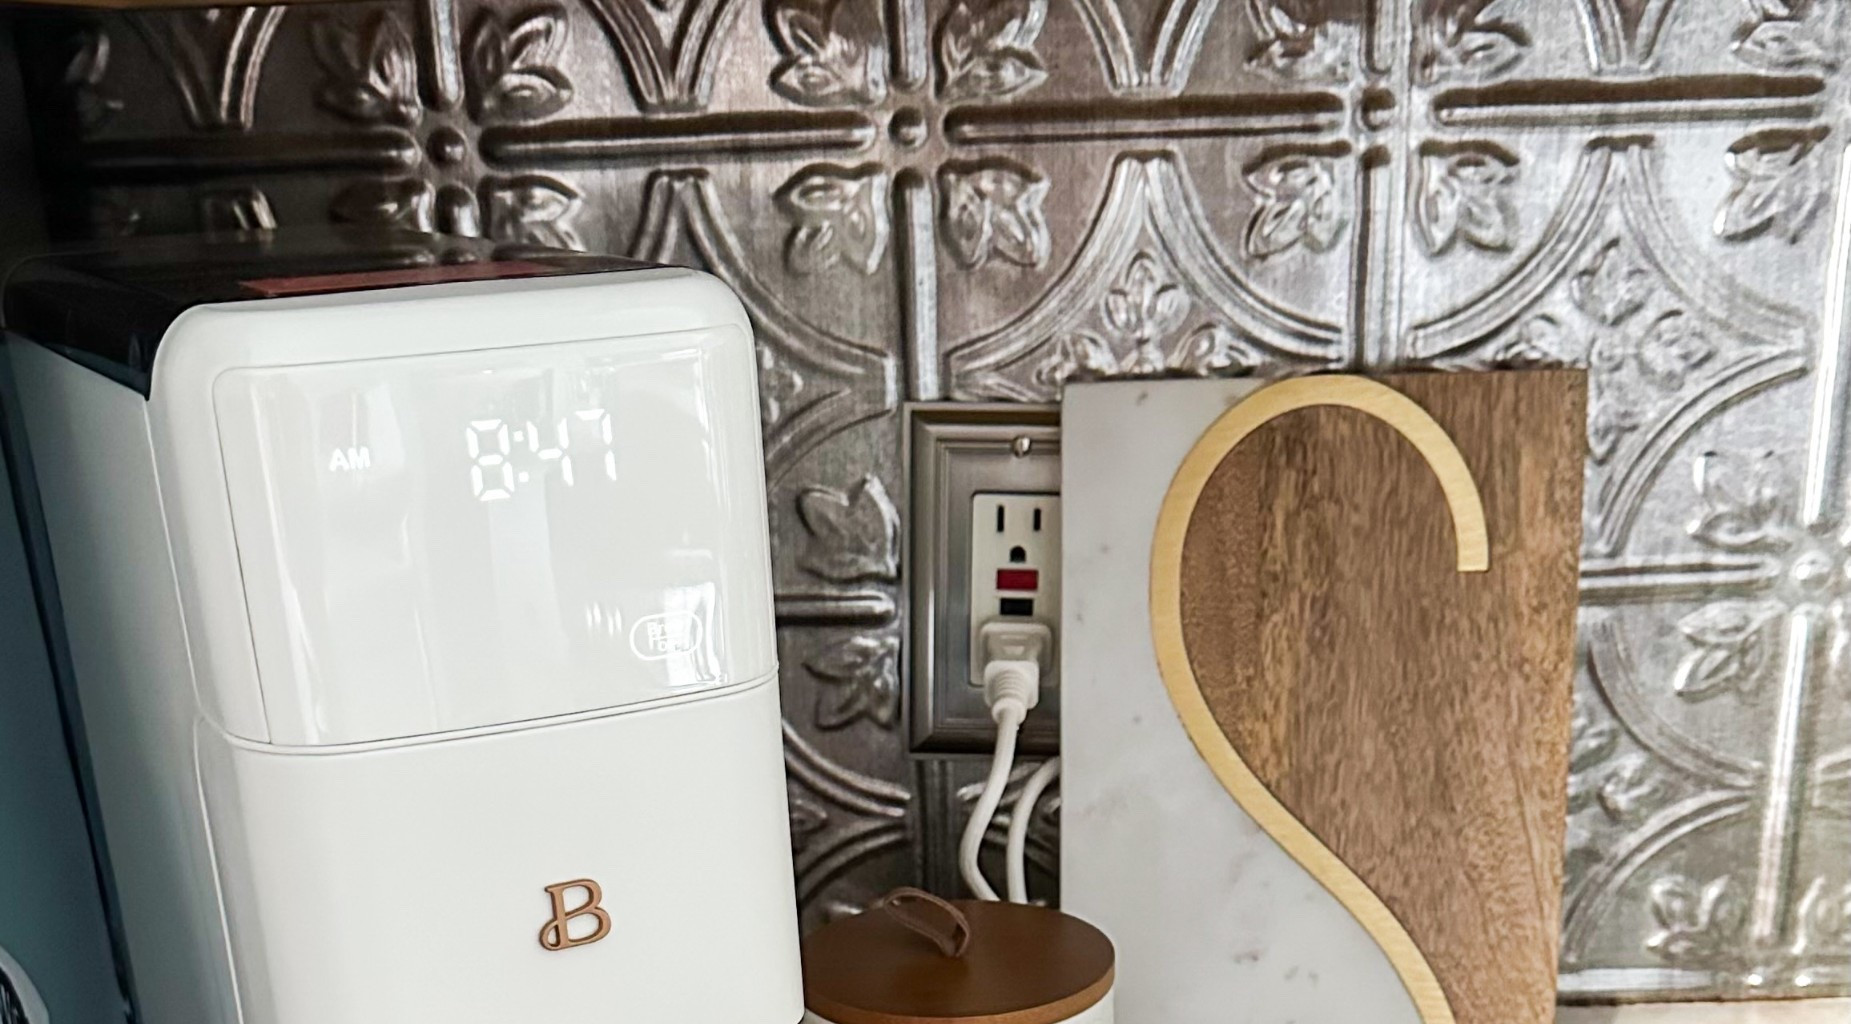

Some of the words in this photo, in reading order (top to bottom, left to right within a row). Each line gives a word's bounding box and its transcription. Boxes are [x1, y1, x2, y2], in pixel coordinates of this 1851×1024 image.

[329, 446, 371, 471] AM
[466, 408, 617, 501] 8:47
[538, 878, 612, 951] B
